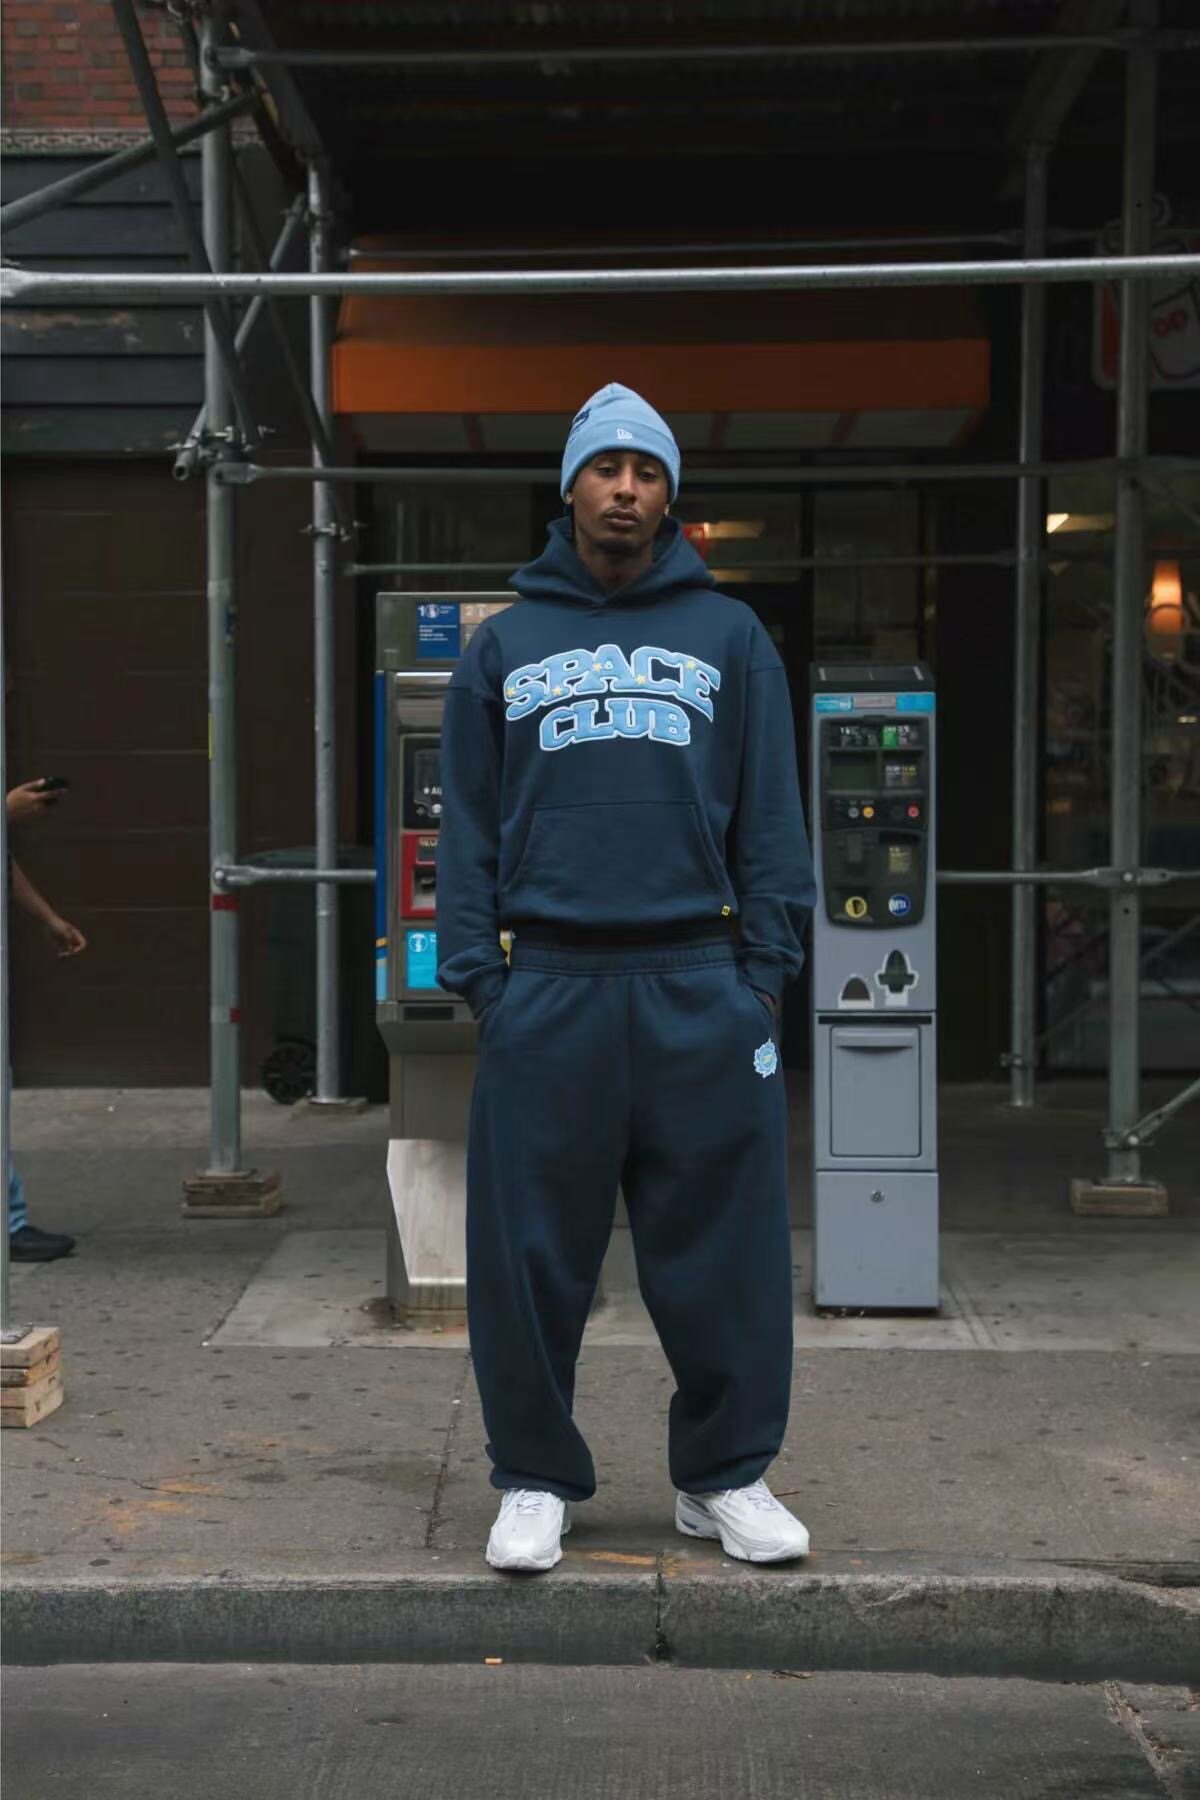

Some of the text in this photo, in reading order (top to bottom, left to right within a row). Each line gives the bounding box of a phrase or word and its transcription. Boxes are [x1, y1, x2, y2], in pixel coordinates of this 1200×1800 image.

[503, 644, 721, 722] SPACE
[539, 697, 691, 751] CLUB
[888, 898, 907, 912] MTA
